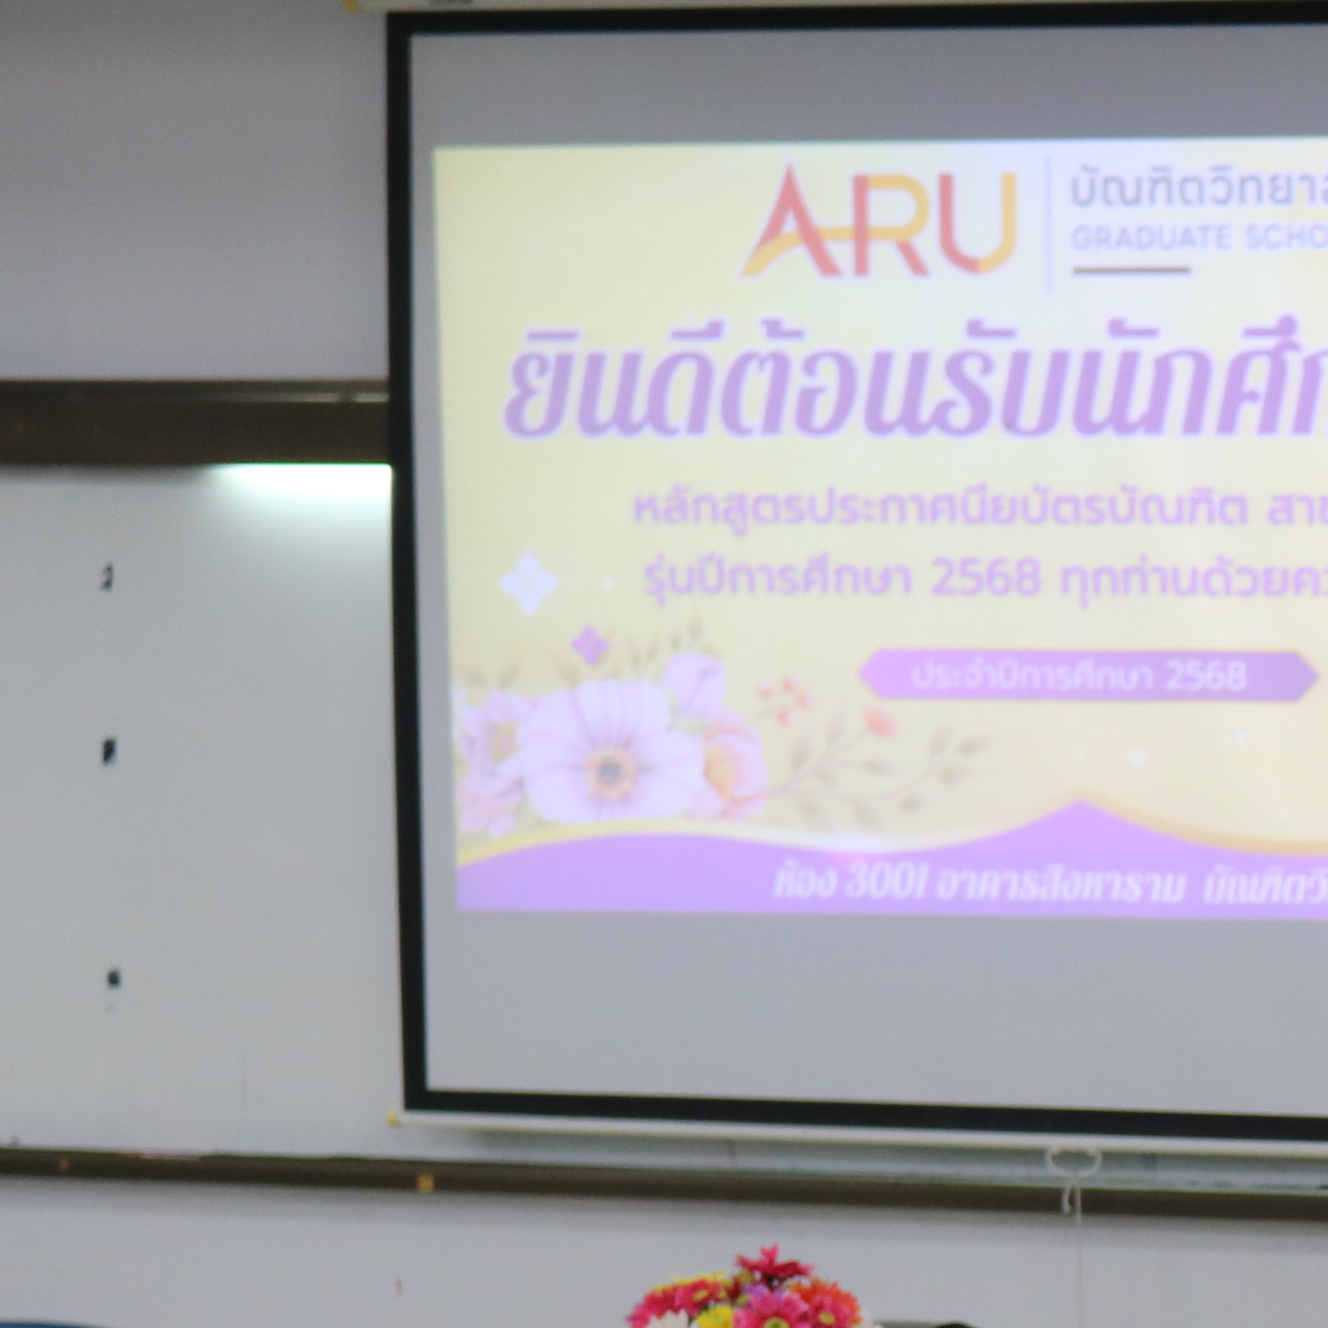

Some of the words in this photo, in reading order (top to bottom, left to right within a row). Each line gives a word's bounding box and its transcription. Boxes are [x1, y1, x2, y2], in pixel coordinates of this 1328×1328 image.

[739, 158, 1018, 279] ARU
[1070, 224, 1233, 252] GRADUATE
[633, 482, 1249, 537] หลักสูตรประกาศนียบัตรบัณฑิต
[643, 552, 913, 607] รุ่นปีการศึกษา
[931, 557, 1042, 598] 2568
[911, 654, 1154, 692] ประจำปีการศึกษา
[1165, 658, 1248, 692] 2568
[773, 858, 839, 900] ห้อง
